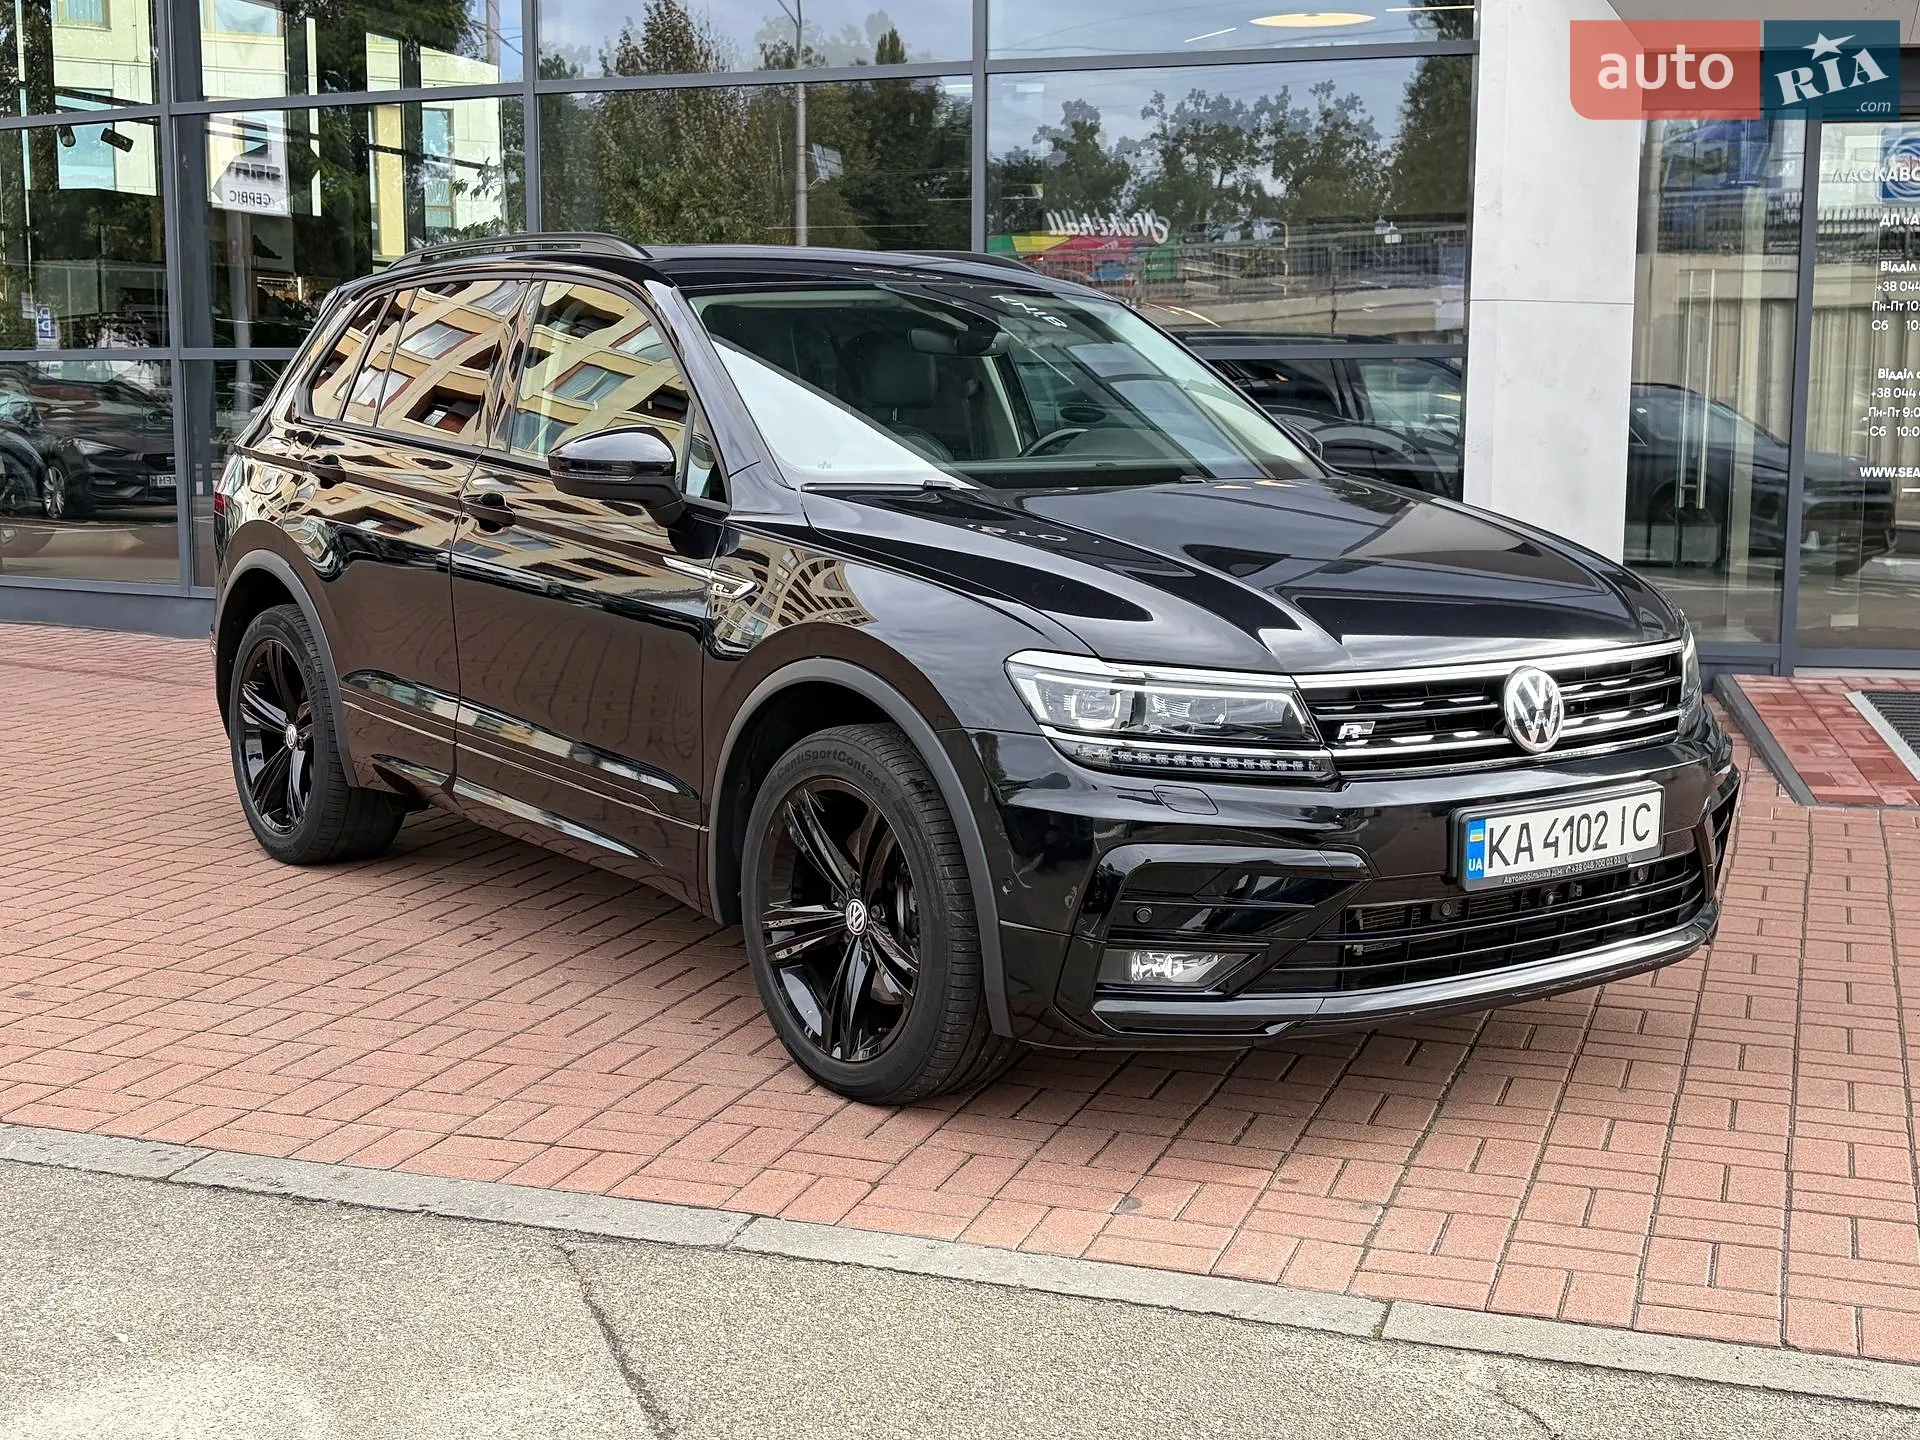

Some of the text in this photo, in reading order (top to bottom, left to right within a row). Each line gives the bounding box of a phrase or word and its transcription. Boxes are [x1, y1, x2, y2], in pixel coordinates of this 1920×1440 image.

[1880, 213, 1900, 228] ДП
[1880, 260, 1917, 273] Відділ
[1876, 281, 1897, 292] +38
[1872, 300, 1904, 312] Пн-Пт
[1871, 319, 1889, 331] Сб
[1877, 368, 1914, 380] Відділ
[1871, 387, 1916, 399] +38 044
[1868, 406, 1900, 418] Пн-Пт
[1869, 425, 1887, 437] Сб
[1488, 803, 1651, 868] KA 4102 IC
[1469, 858, 1483, 872] UA
